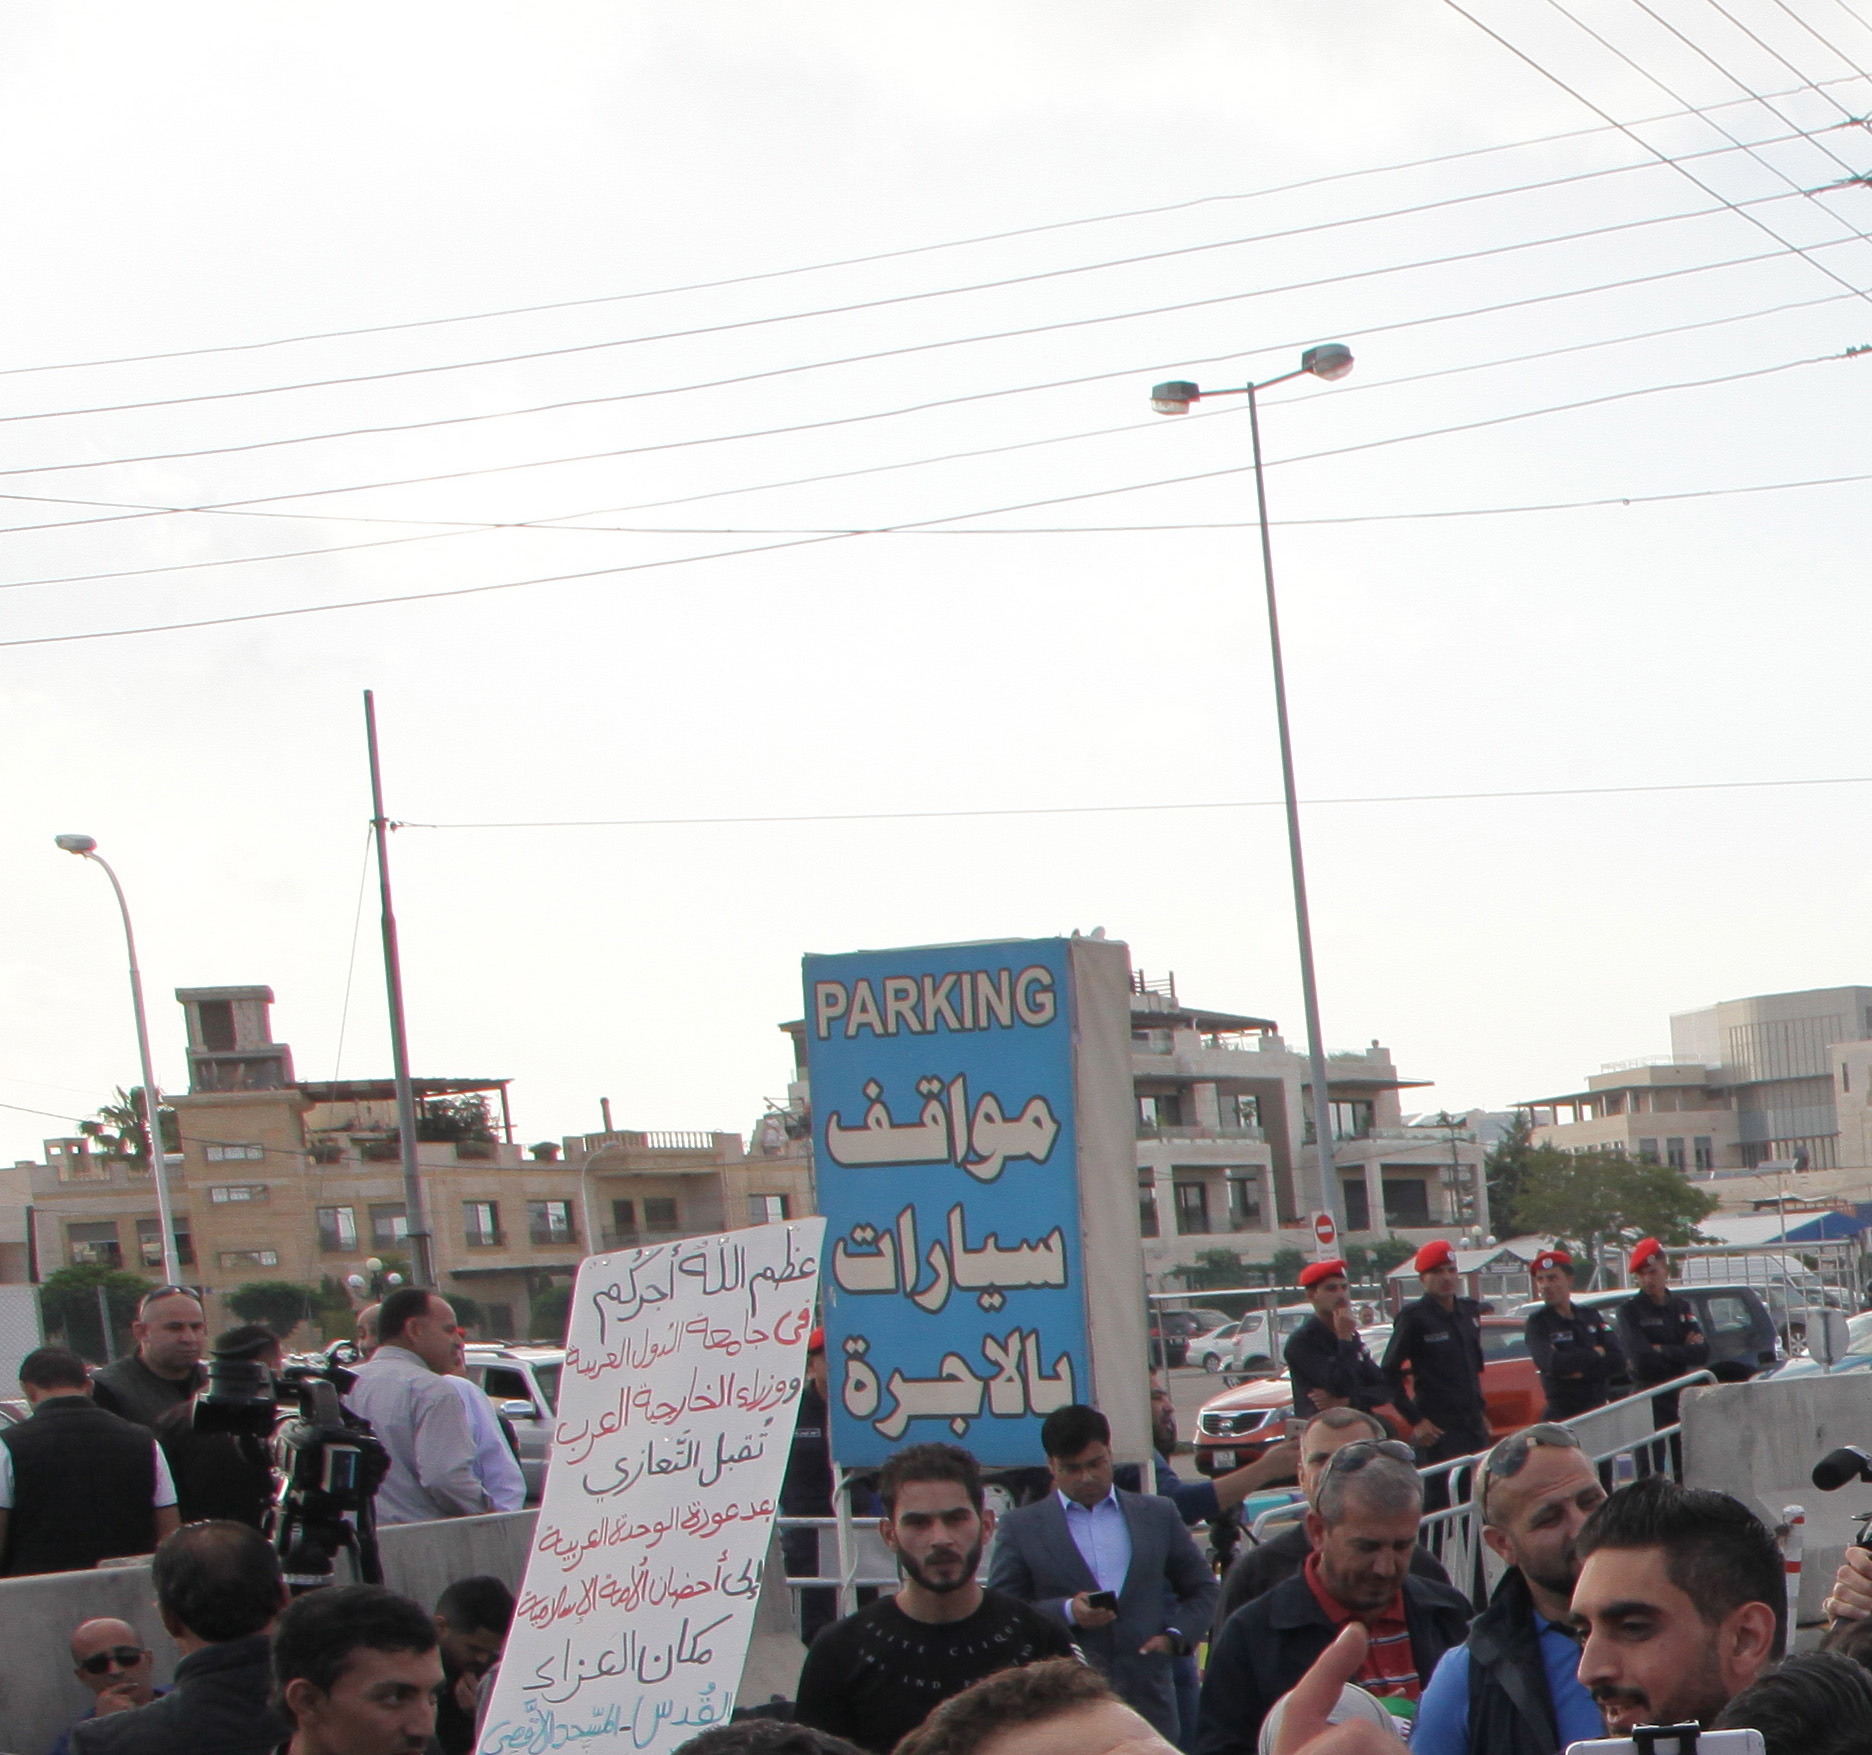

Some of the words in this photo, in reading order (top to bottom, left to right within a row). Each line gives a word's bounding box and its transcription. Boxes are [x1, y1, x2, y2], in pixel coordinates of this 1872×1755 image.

[815, 965, 1056, 1040] PARKING
[825, 1072, 1060, 1181] مواقف
[831, 1202, 1068, 1313] سيارات
[632, 1366, 736, 1426] الخارجية
[842, 1327, 1074, 1442] بالاجرة
[556, 1385, 631, 1465] العرب
[522, 1629, 636, 1704] العزاء
[638, 1613, 734, 1685] مكان
